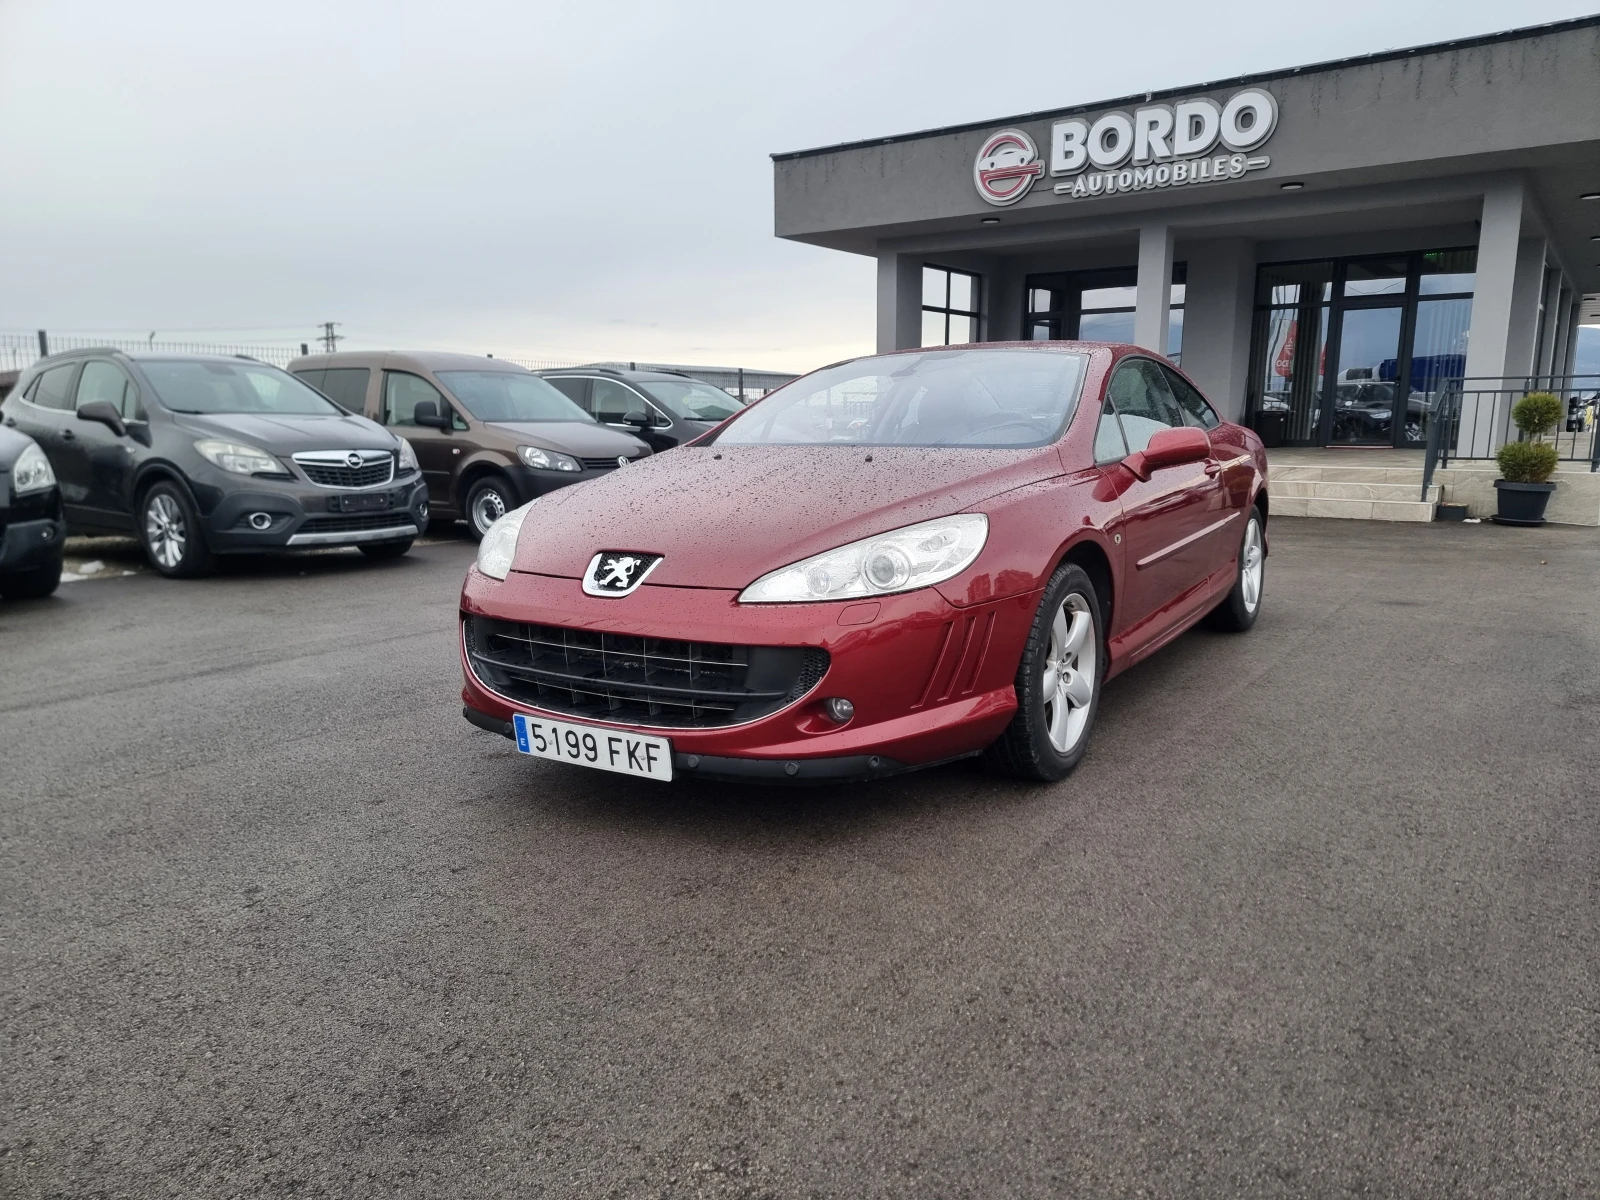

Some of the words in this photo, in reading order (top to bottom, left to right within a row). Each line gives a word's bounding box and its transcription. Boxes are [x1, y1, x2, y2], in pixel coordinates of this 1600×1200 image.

[1051, 91, 1273, 172] BORDO
[1072, 156, 1244, 194] AUTOMOBILES
[520, 737, 527, 747] E
[531, 723, 598, 762] 5199
[607, 736, 661, 772] FKF
